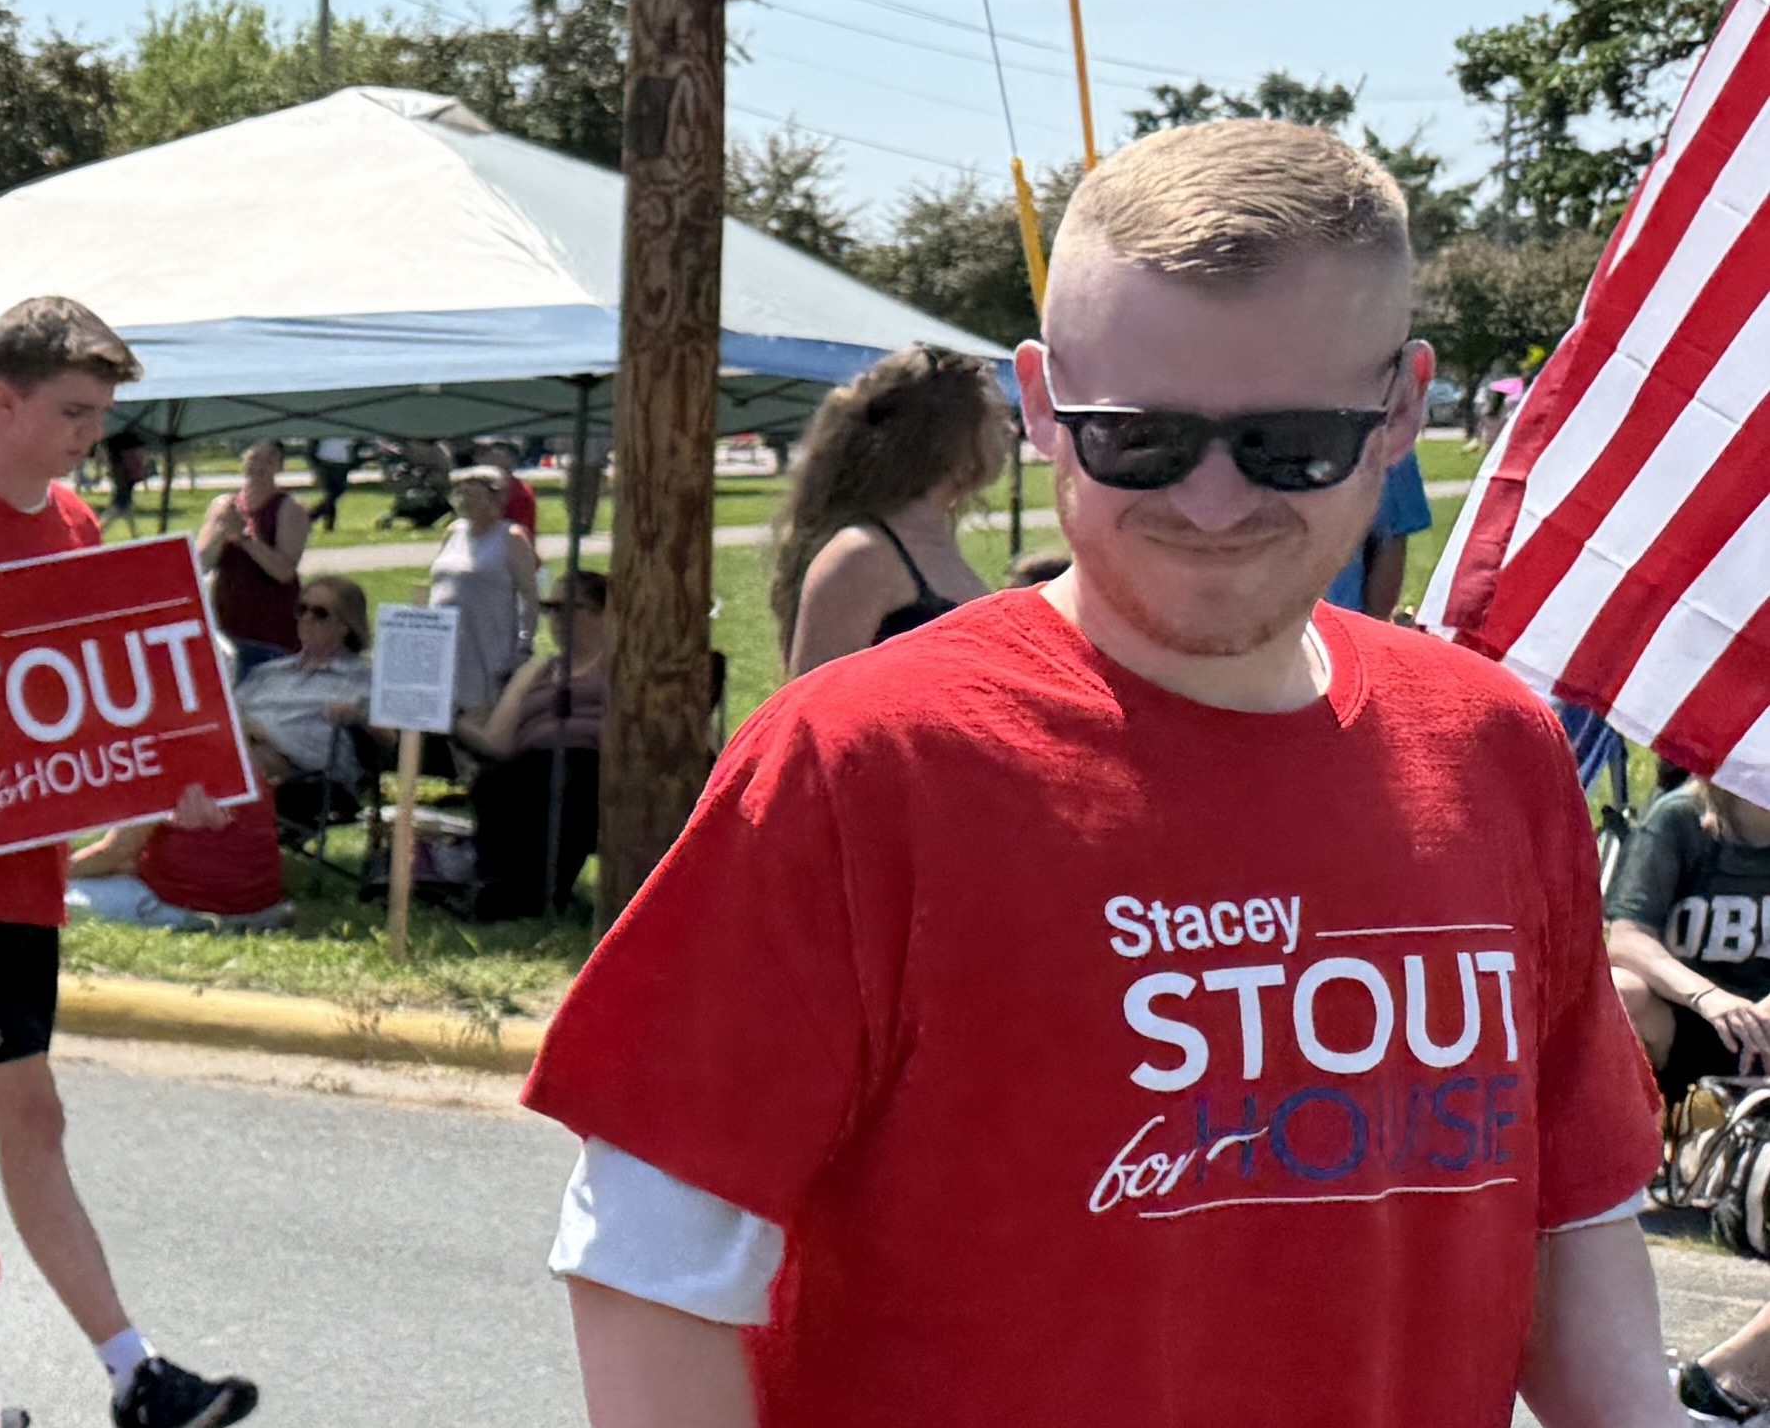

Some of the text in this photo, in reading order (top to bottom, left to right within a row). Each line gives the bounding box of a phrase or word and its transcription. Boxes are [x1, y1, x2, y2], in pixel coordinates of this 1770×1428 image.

[14, 734, 164, 801] HOUSE
[1104, 895, 1300, 958] Stacey
[1664, 894, 1770, 963] OB
[1123, 951, 1518, 1093] STOUT
[1088, 1075, 1519, 1214] for HOUSE
